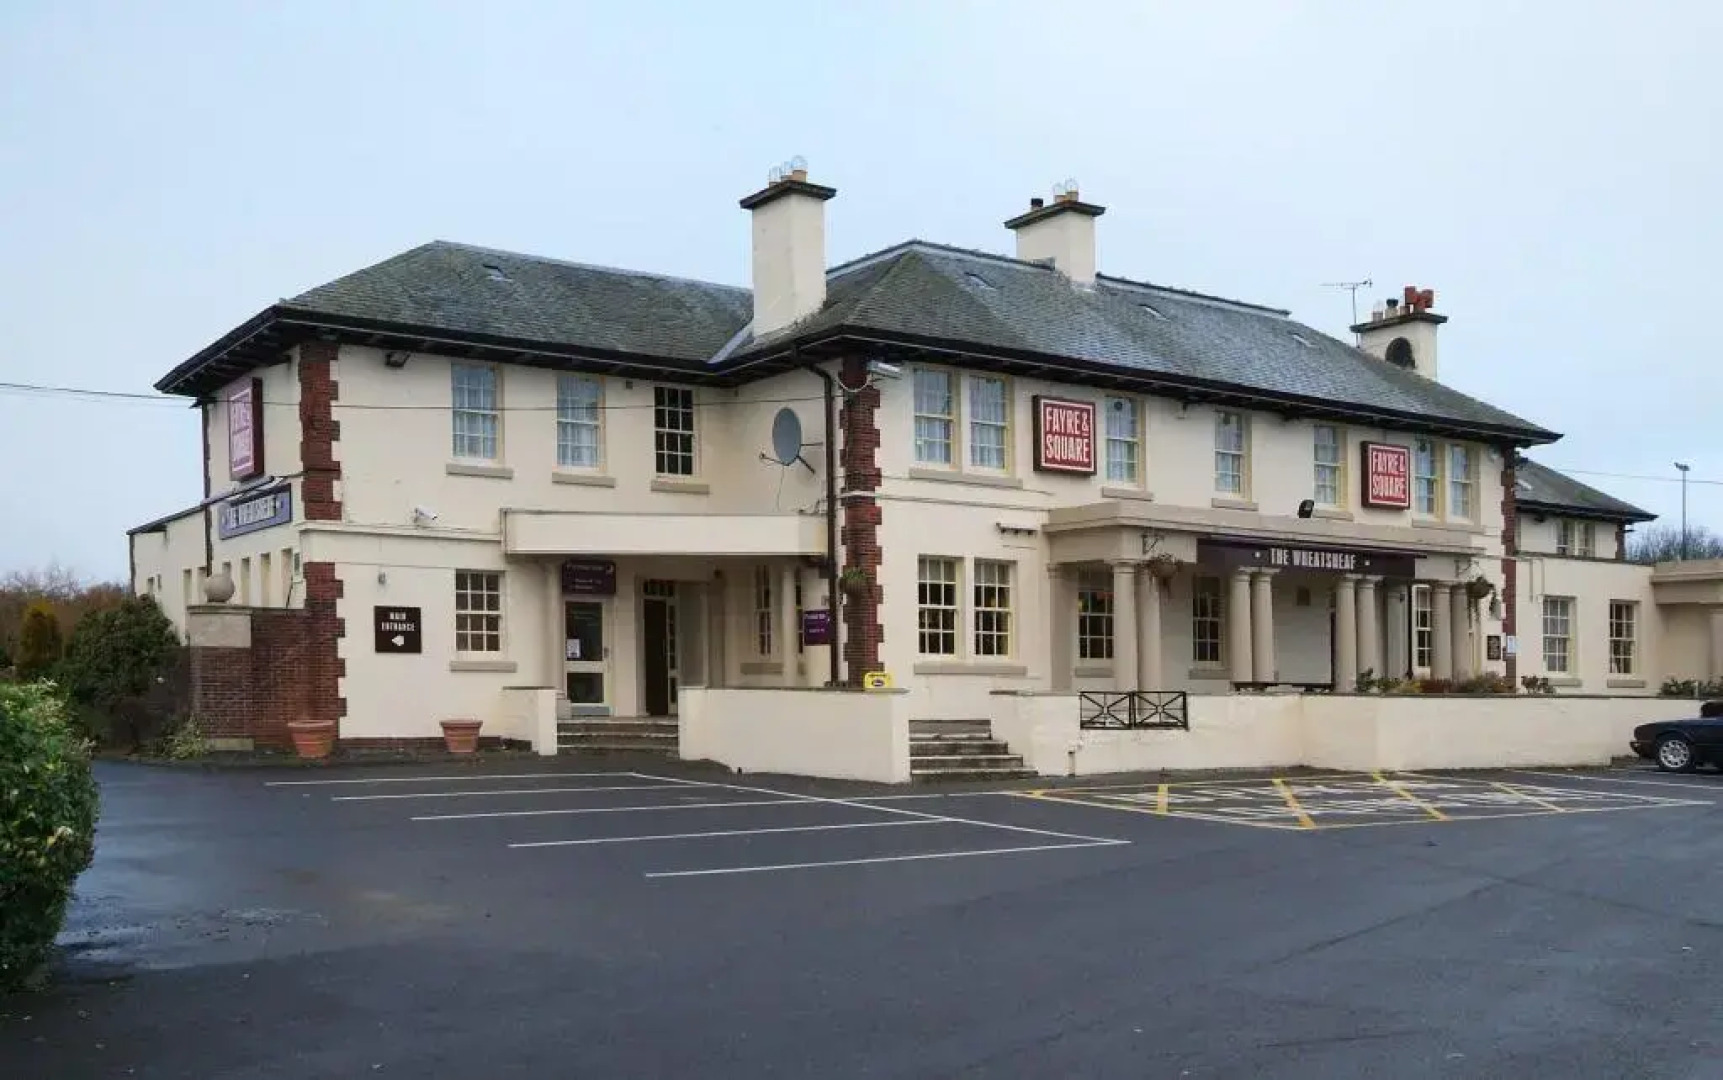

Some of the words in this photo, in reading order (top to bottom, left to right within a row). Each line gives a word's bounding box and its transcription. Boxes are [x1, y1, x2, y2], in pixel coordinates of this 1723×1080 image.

[1045, 406, 1081, 435] FAYRE
[1081, 411, 1089, 436] &
[1045, 434, 1090, 462] SQUARE
[1270, 547, 1290, 565] THE
[1292, 549, 1357, 570] WHEATSHEAF
[381, 621, 415, 632] ENTRANCE
